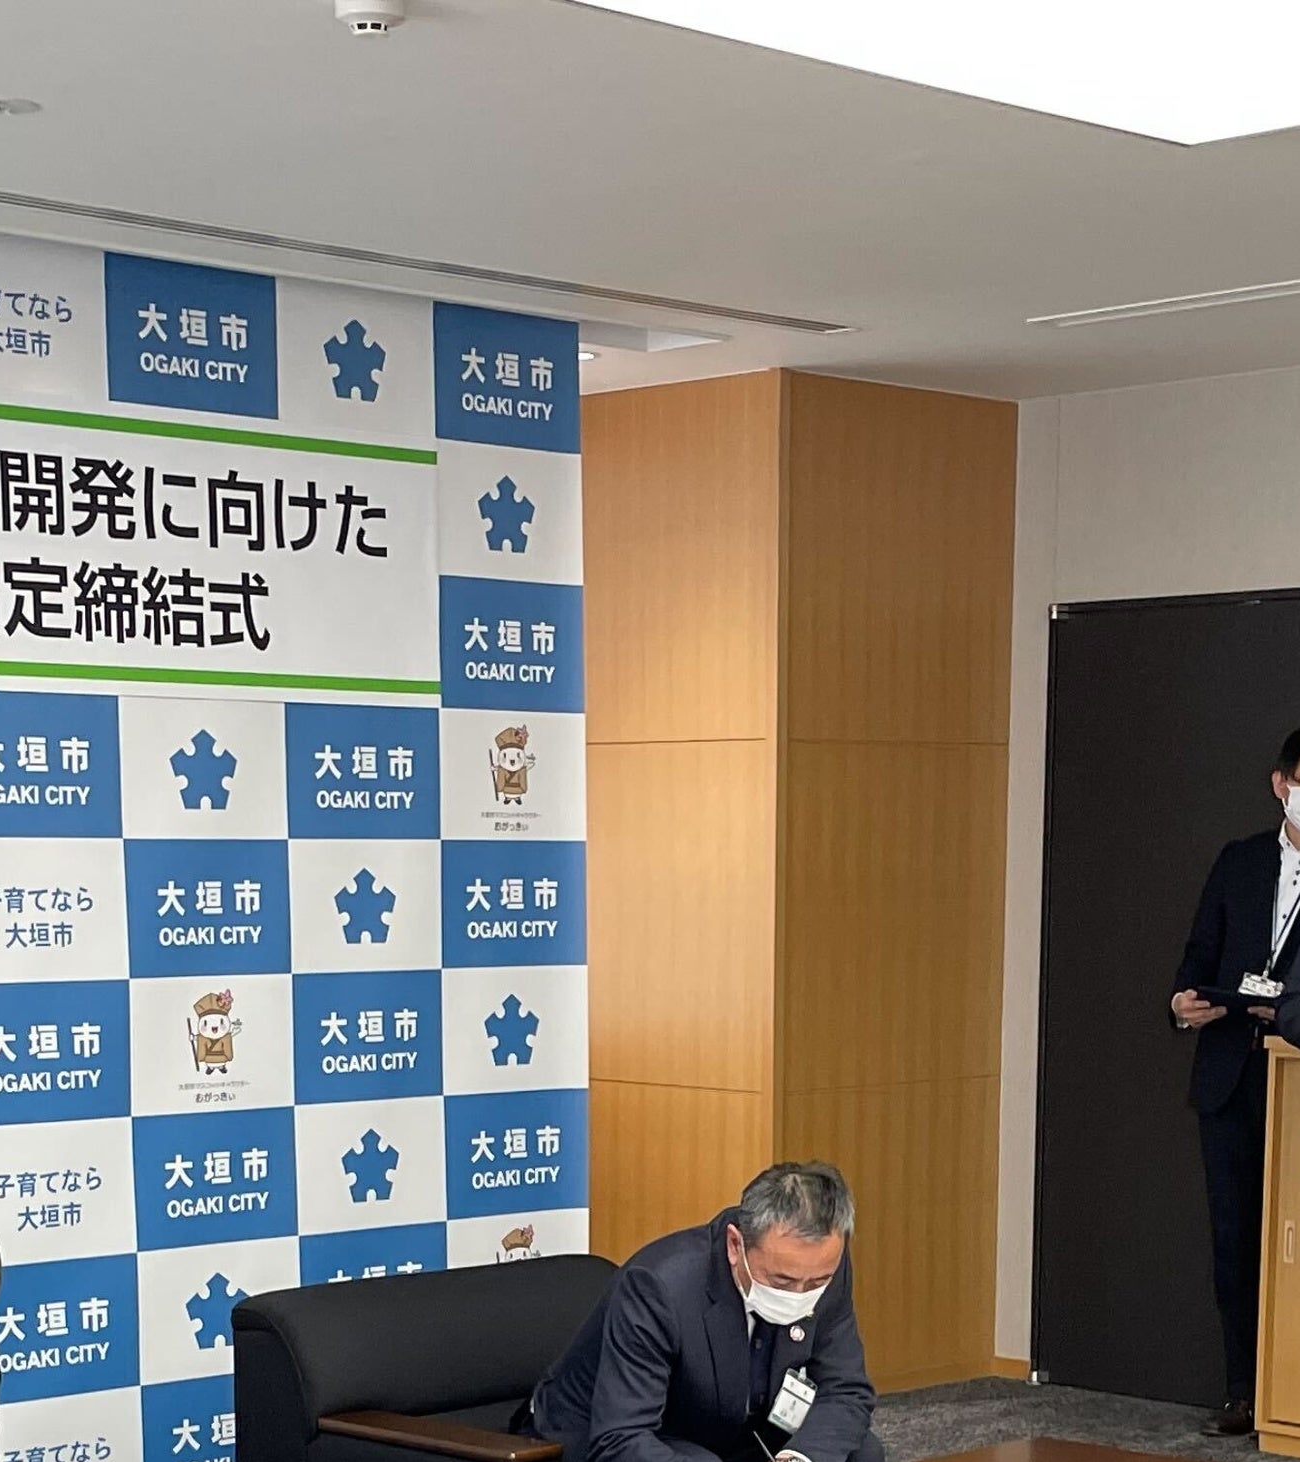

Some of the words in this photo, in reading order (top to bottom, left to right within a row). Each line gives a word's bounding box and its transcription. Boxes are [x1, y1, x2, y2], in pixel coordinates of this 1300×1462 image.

[137, 303, 248, 351] 大垣市
[140, 352, 200, 378] OGAKI
[204, 360, 248, 383] CITY
[461, 347, 554, 391] 大垣市
[461, 392, 513, 416] OGAKI
[516, 400, 553, 421] CITY
[464, 617, 556, 655] 大垣市
[465, 661, 515, 682] OGAKI
[519, 664, 556, 683] CITY
[314, 744, 414, 781] 大垣市
[44, 785, 90, 805] CITY
[316, 790, 370, 809] OGAKI
[374, 791, 414, 810] CITY
[157, 879, 261, 917] 大垣市
[465, 877, 558, 912] 大垣市
[5, 922, 73, 948] 大垣市
[158, 926, 215, 946] OGAKI
[219, 925, 262, 945] CITY
[467, 921, 518, 939] OGAKI
[521, 920, 558, 938] CITY
[320, 1008, 418, 1046] 大垣市
[322, 1053, 377, 1074] OGAKI
[381, 1051, 418, 1071] CITY
[56, 1069, 102, 1090] CITY
[471, 1125, 561, 1163] 大垣市
[164, 1147, 269, 1190] 大垣市
[472, 1169, 521, 1190] OGAKI
[524, 1165, 560, 1185] CITY
[16, 1201, 82, 1231] 大垣市
[166, 1195, 223, 1218] OGAKI
[228, 1191, 269, 1212] CITY
[65, 1341, 110, 1365] CITY
